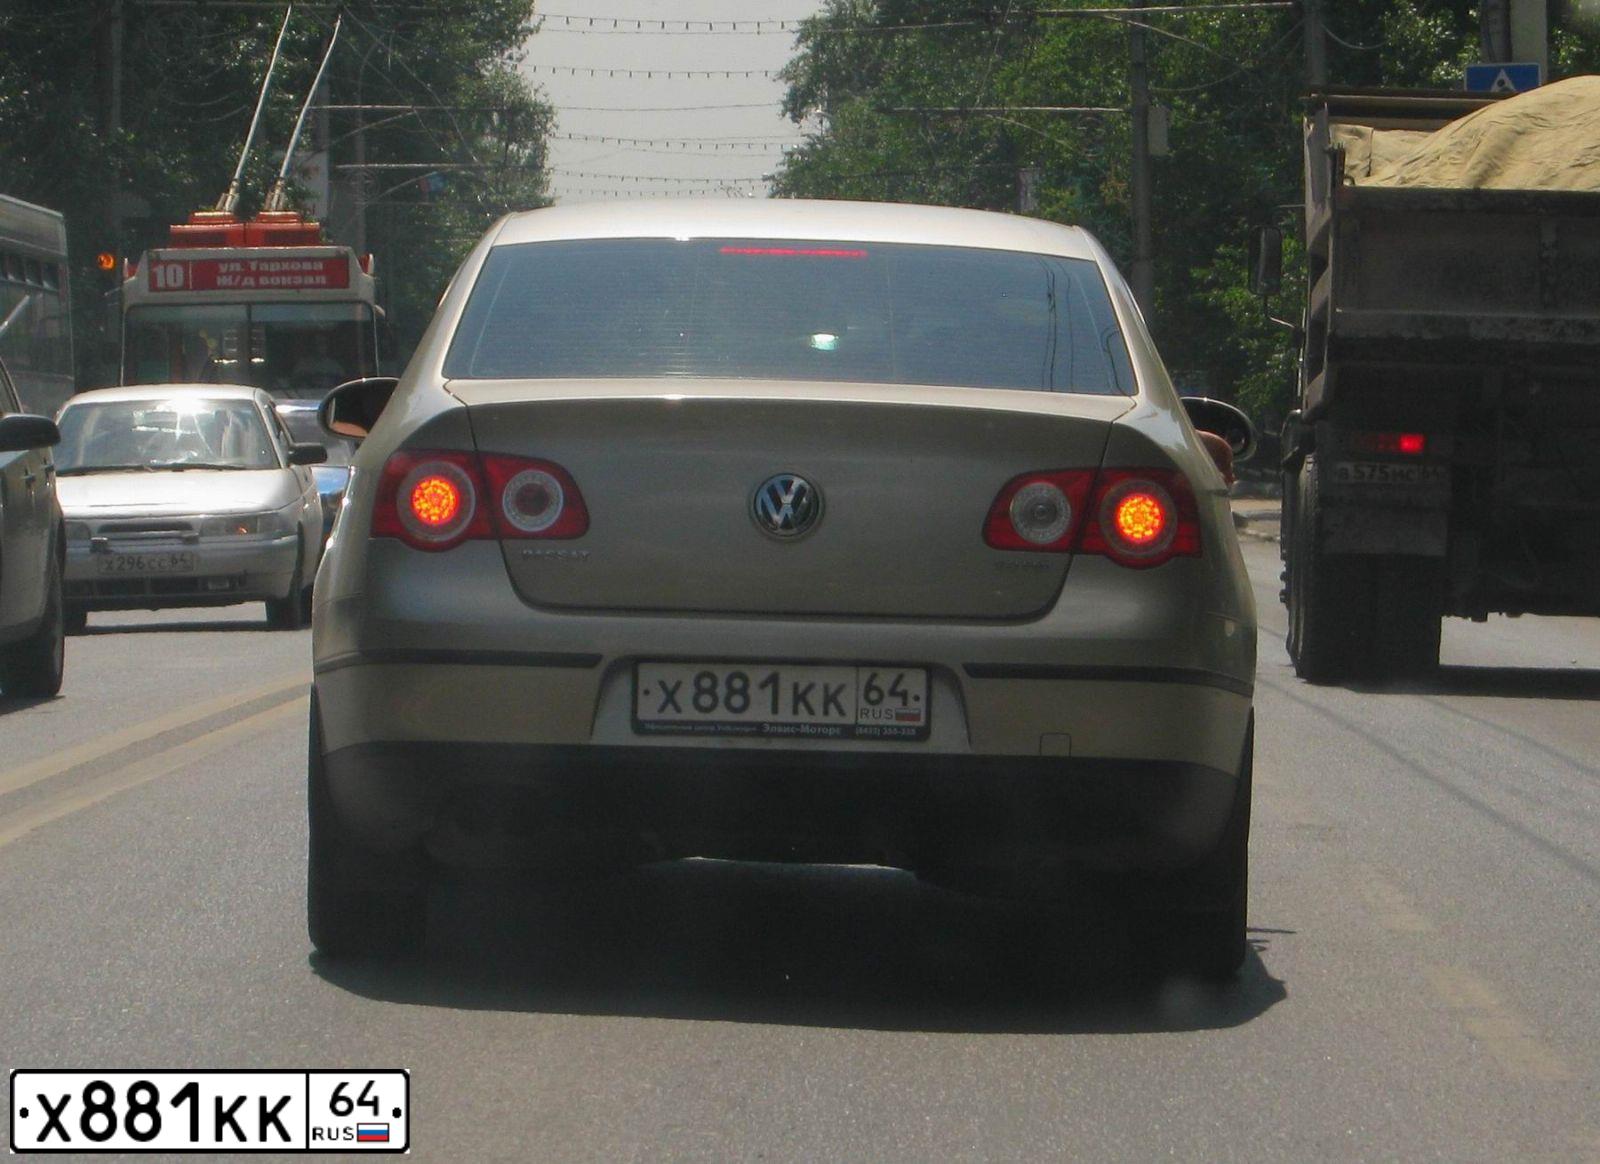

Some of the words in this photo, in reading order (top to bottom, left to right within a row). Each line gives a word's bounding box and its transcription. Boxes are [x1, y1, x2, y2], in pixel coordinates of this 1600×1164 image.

[153, 264, 184, 288] 10
[259, 274, 327, 286] вокзал
[657, 670, 847, 716] Х881КК
[863, 672, 908, 706] 64
[859, 708, 894, 720] RUS
